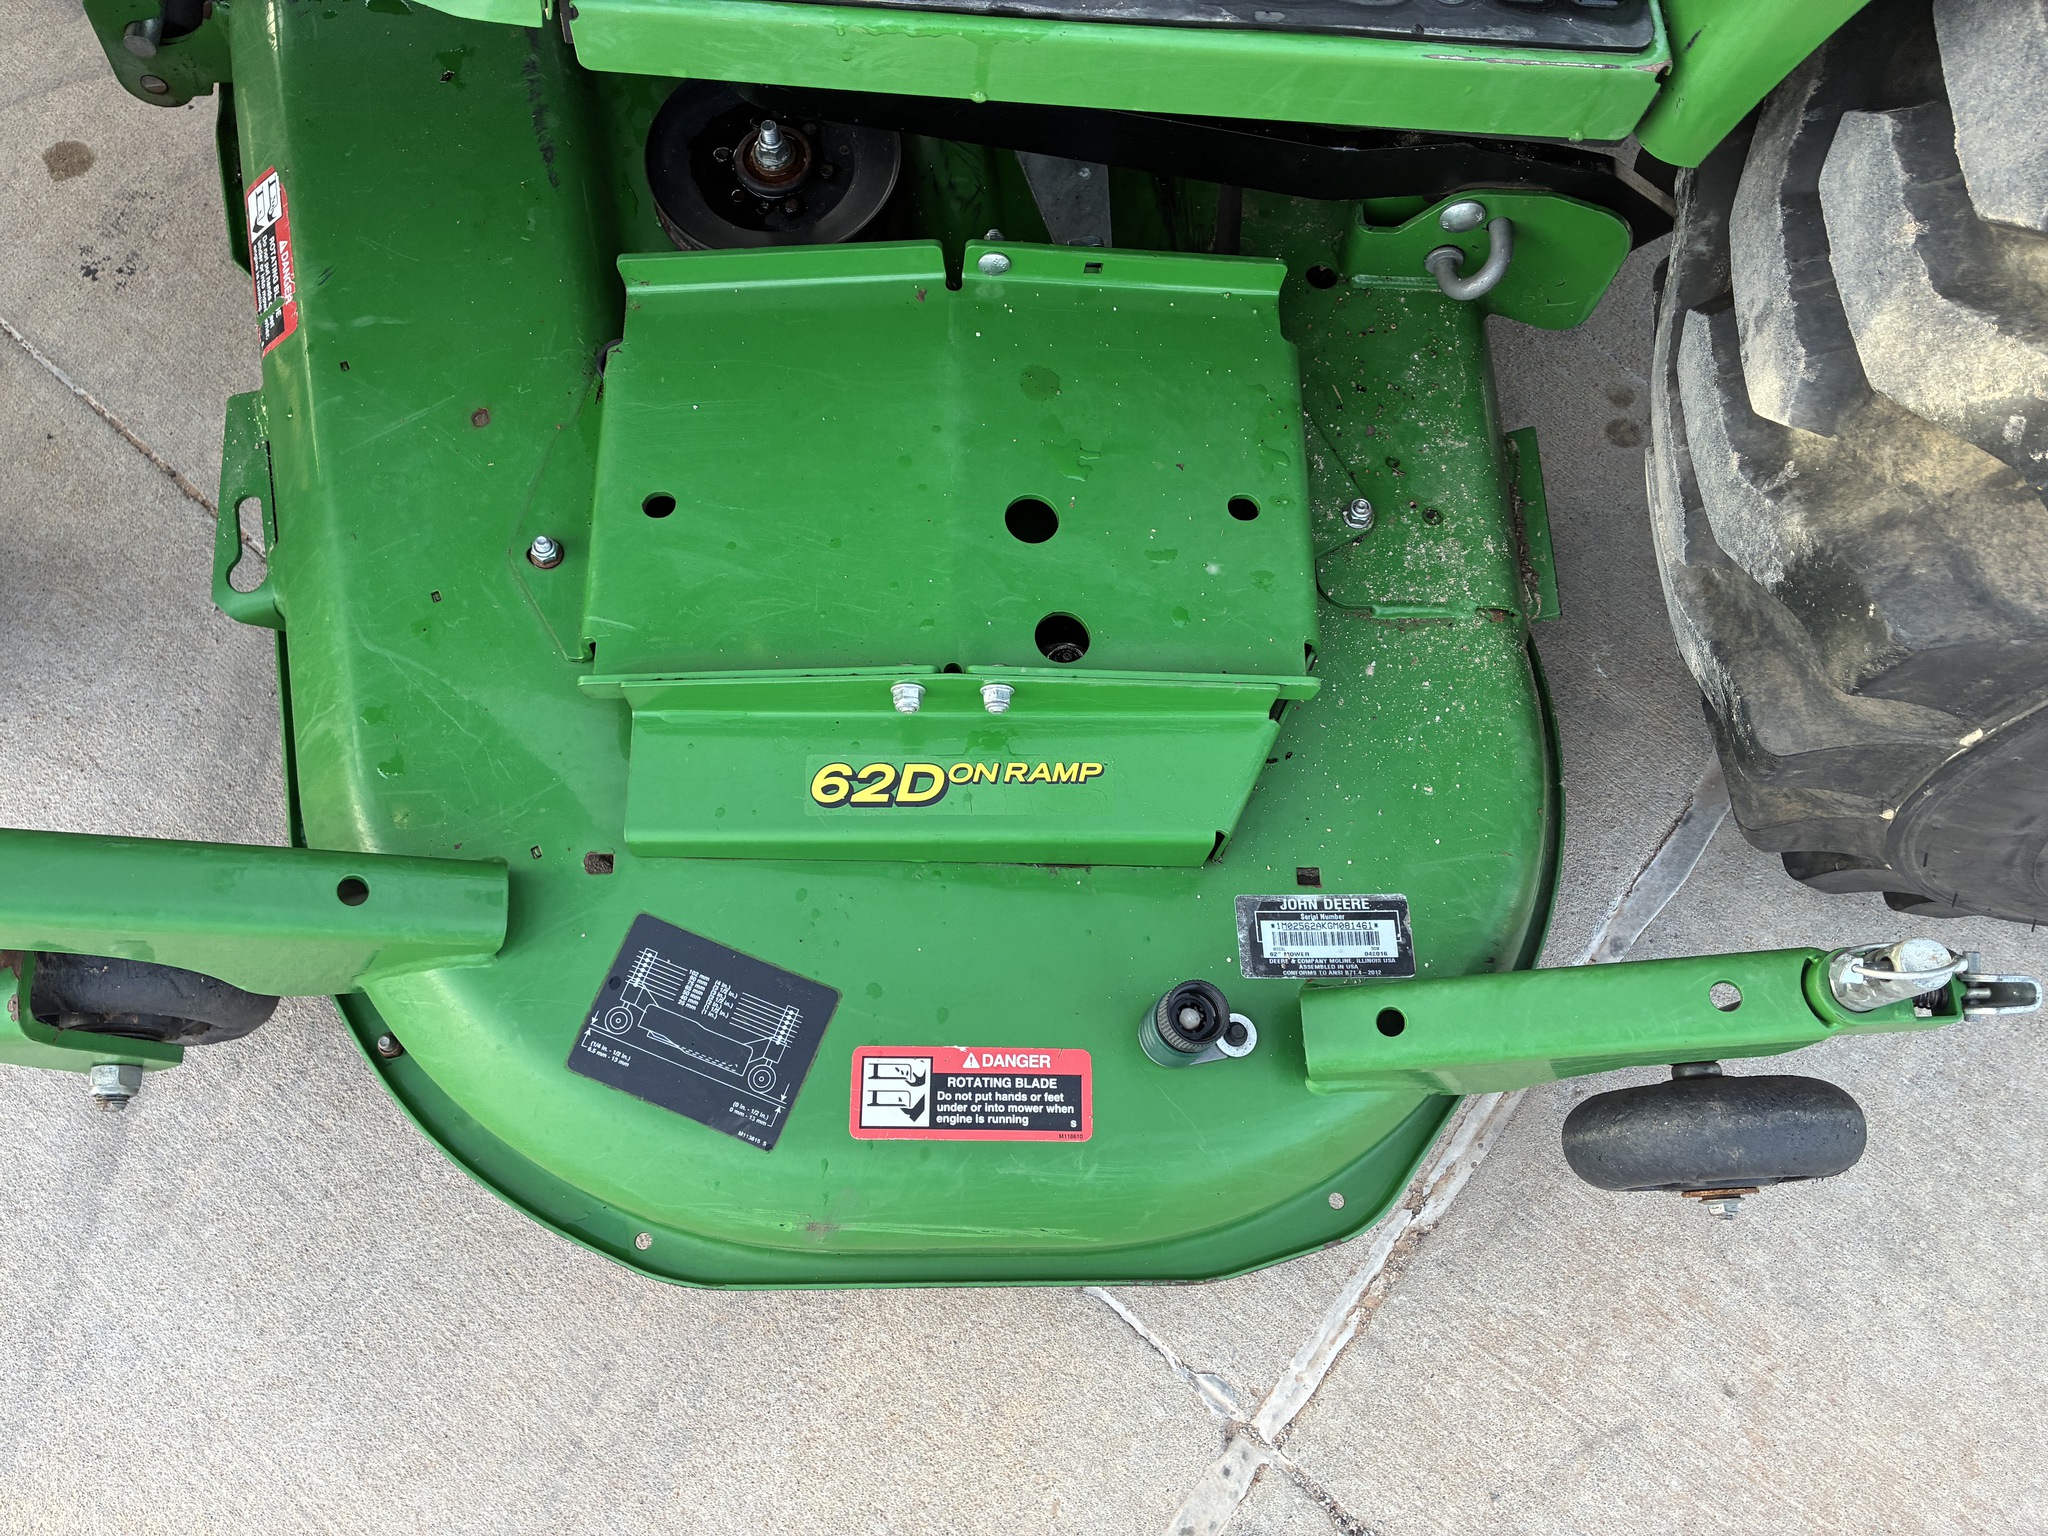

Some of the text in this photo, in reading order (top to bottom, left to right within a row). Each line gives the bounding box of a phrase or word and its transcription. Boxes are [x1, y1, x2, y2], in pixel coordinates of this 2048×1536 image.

[269, 235, 280, 284] ROTATING
[281, 250, 294, 305] DANGER
[810, 762, 1105, 808] 62D ON RAMP
[1280, 898, 1370, 911] JOHN DEERE
[1300, 913, 1345, 921] Serial Number
[981, 1053, 1051, 1068] DANGER
[947, 1076, 1058, 1089] ROTATING BLADE
[937, 1090, 1064, 1103] Do not put hands or feet
[936, 1103, 1075, 1114] under or into mower when
[936, 1114, 1029, 1126] engine is running
